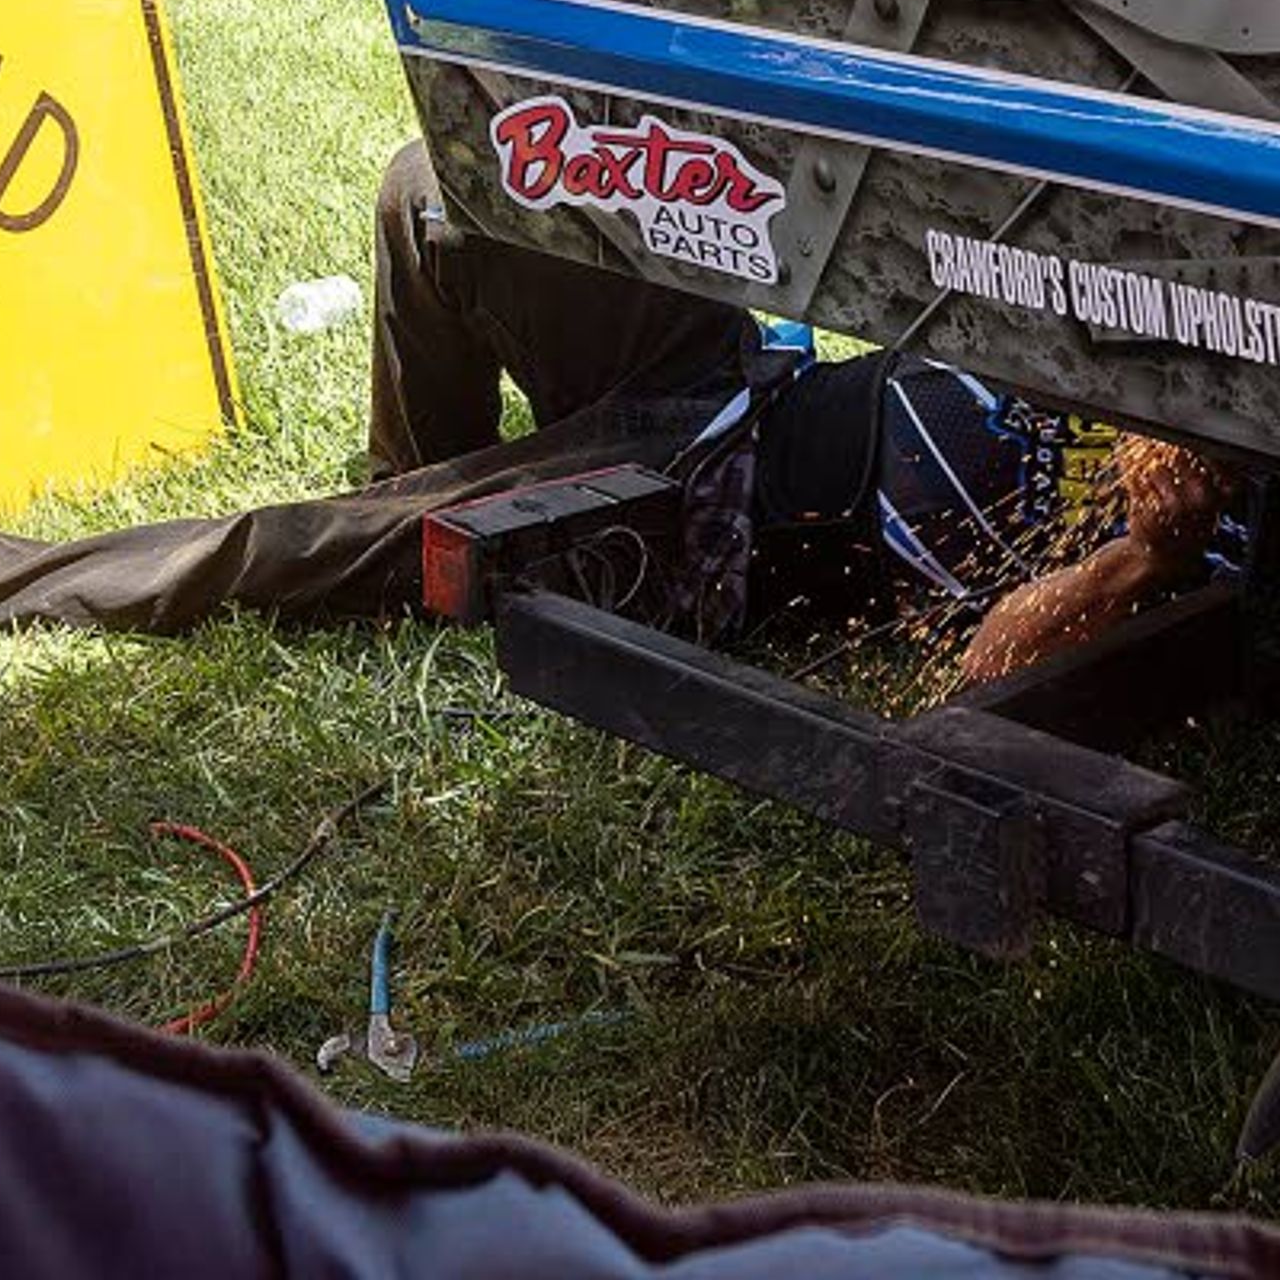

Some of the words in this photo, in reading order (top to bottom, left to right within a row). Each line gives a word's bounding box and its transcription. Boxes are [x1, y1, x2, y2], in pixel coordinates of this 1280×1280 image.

[496, 101, 784, 214] Baxter
[647, 226, 774, 282] PARTS
[652, 204, 761, 249] AUTO
[925, 228, 1067, 316] CRAWFORD'S
[1069, 258, 1169, 341] CUSTOM
